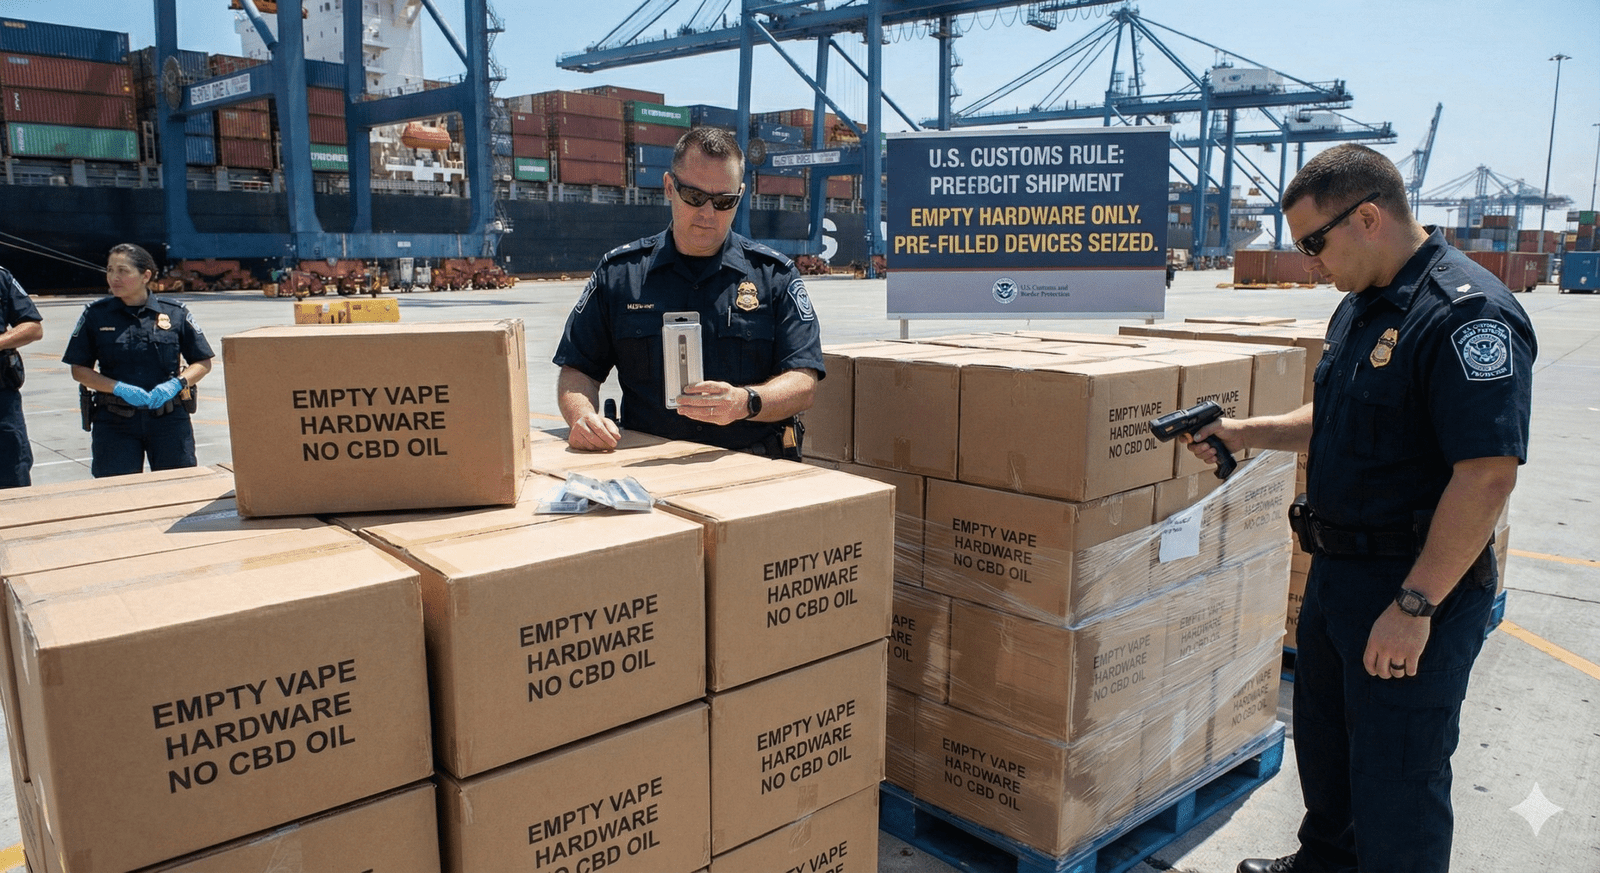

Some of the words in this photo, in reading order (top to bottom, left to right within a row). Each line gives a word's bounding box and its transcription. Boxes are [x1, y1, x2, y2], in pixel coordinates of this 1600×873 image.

[929, 148, 964, 168] U.S.
[970, 146, 1063, 167] CUSTOMS
[1069, 144, 1125, 164] RULE:
[1025, 173, 1124, 194] SHIPMENT
[911, 207, 974, 227] EMPTY
[979, 205, 1086, 226] HARDWARE
[1091, 204, 1142, 225] ONLY.
[894, 234, 999, 254] PRE-FILLED
[1004, 232, 1082, 253] DEVICES
[1088, 232, 1159, 252] SEIZED.
[292, 387, 378, 409] EMPTY
[384, 384, 449, 405] VAPE
[1109, 405, 1139, 422] EMPTY
[1140, 401, 1162, 417] VAPE
[1221, 390, 1239, 404] VAPE
[300, 411, 446, 435] HARDWARE
[1109, 422, 1151, 440] HARDWA
[302, 441, 339, 461] NO
[347, 439, 399, 459] CBD
[407, 437, 448, 456] OIL
[1109, 444, 1122, 459] NO
[1124, 440, 1142, 456] CBD
[1144, 437, 1157, 451] OIL
[952, 517, 997, 538] EMPTY
[1000, 528, 1037, 548] VAPE
[763, 552, 819, 581] EMPTY
[823, 541, 862, 566] VAPE
[955, 535, 1033, 565] HARDWARE
[768, 564, 858, 604] HARDWARE
[953, 552, 973, 568] NO
[977, 558, 1005, 576] CBD
[1009, 566, 1032, 583] OIL
[520, 609, 597, 648] EMPTY
[603, 594, 658, 625] VAPE
[767, 606, 791, 628] NO
[795, 596, 829, 619] CBD
[834, 588, 858, 608] OIL
[892, 614, 916, 631] APE
[527, 621, 654, 674] HARDWARE
[893, 646, 913, 662] OIL
[1093, 644, 1126, 669] EMPTY
[1128, 634, 1151, 654] VAPE
[528, 675, 562, 702] NO
[569, 660, 615, 689] CBD
[621, 649, 656, 673] OIL
[1094, 651, 1147, 685] HARDWARE
[152, 679, 267, 730] EMPTY
[275, 658, 357, 698] VAPE
[1093, 686, 1108, 703] NO
[1110, 676, 1129, 694] CBD
[1132, 669, 1146, 684] OIL
[166, 691, 352, 761] HARDWARE
[757, 715, 812, 752] EMPTY
[816, 699, 855, 728] VAPE
[168, 760, 218, 794] NO
[229, 739, 296, 776] CBD
[306, 724, 356, 754] OIL
[761, 722, 852, 773] HARDWARE
[942, 737, 986, 763] EMPTY
[990, 754, 1026, 779] VAPE
[761, 771, 785, 795] NO
[790, 756, 823, 782] CBD
[827, 745, 852, 766] OIL
[945, 754, 1021, 795] HARDWARE
[944, 770, 962, 788] NO
[967, 780, 995, 800] CBD
[998, 792, 1022, 812] OIL
[528, 799, 604, 845] EMPTY
[609, 776, 663, 812] VAPE
[535, 803, 659, 869] HARDWARE
[576, 845, 621, 873] CBD
[627, 830, 660, 856] OIL
[809, 840, 848, 873] VAPE
